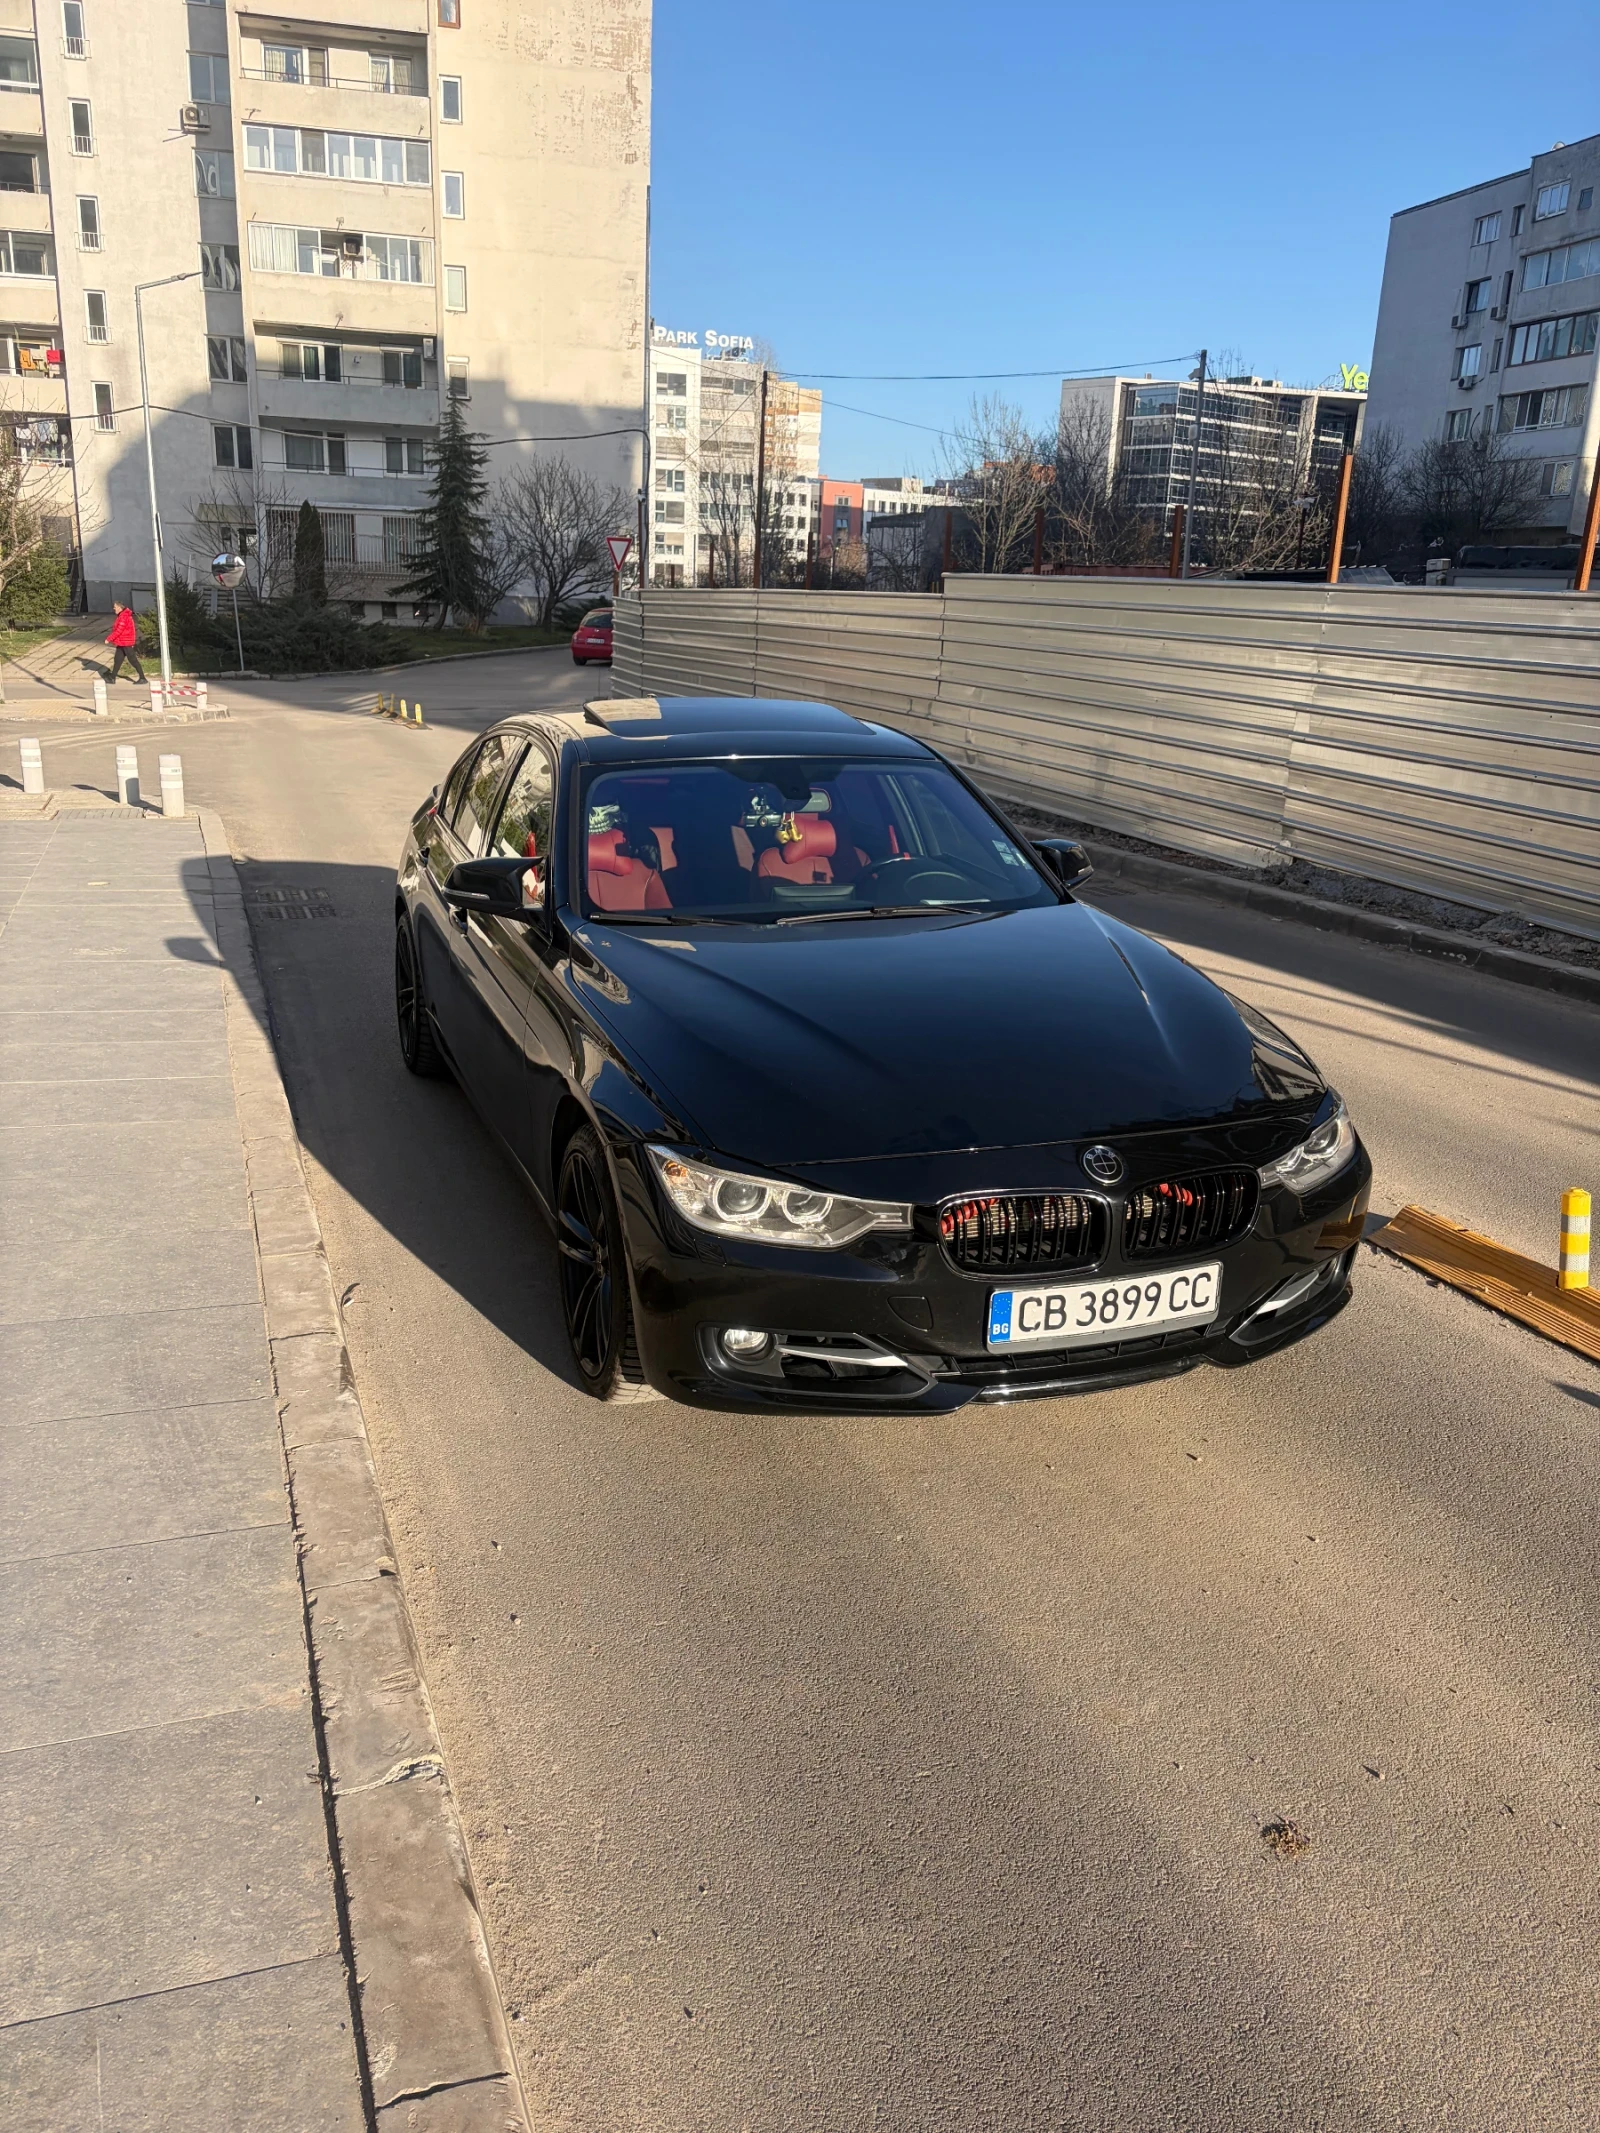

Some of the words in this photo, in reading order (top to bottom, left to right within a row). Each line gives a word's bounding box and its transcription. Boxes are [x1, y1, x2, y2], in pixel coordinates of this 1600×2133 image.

[654, 325, 698, 345] PARK
[705, 329, 754, 350] SOFIA
[1018, 1294, 1067, 1332] CB
[1075, 1281, 1162, 1327] 3899
[1168, 1272, 1212, 1313] CC
[992, 1323, 1009, 1335] BG
